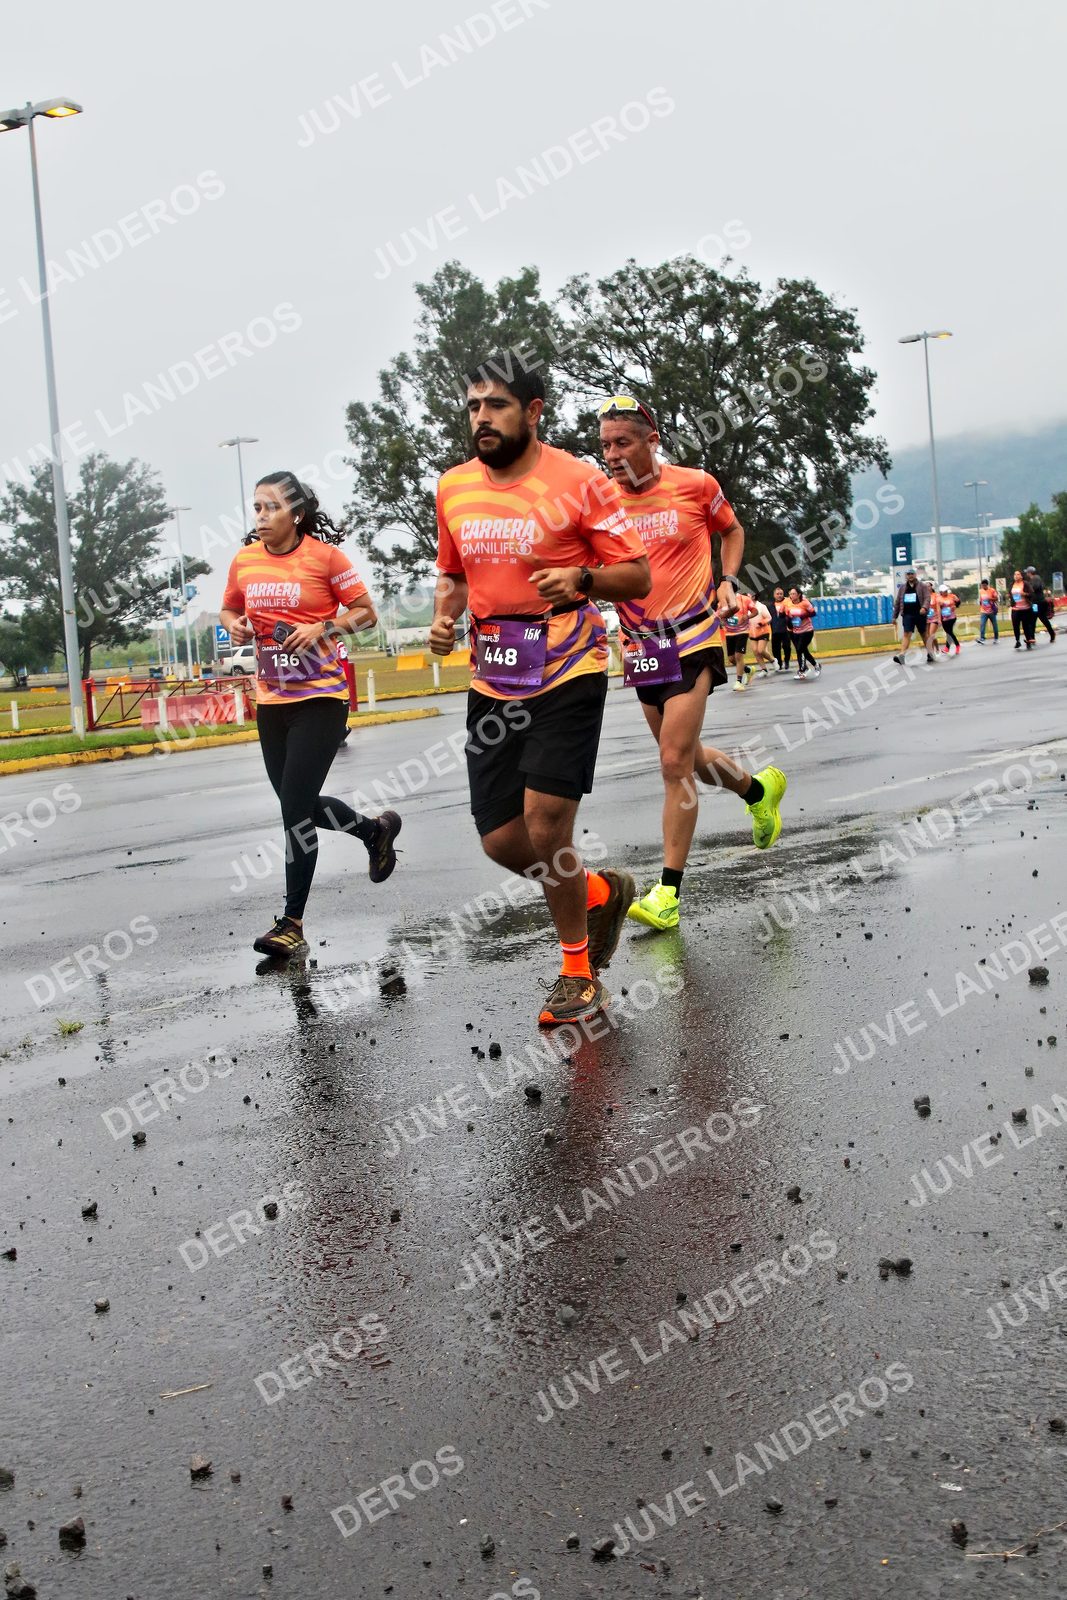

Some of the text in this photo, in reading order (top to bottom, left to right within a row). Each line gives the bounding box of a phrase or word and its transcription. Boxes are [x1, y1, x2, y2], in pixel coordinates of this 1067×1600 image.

[461, 518, 536, 541] CARRERA
[462, 542, 515, 556] OMNILIFE
[896, 547, 907, 561] E
[246, 582, 301, 597] CARRERA
[247, 599, 286, 608] OMNILIFE
[271, 653, 300, 667] 136
[485, 646, 518, 666] 448
[632, 657, 659, 673] 269
